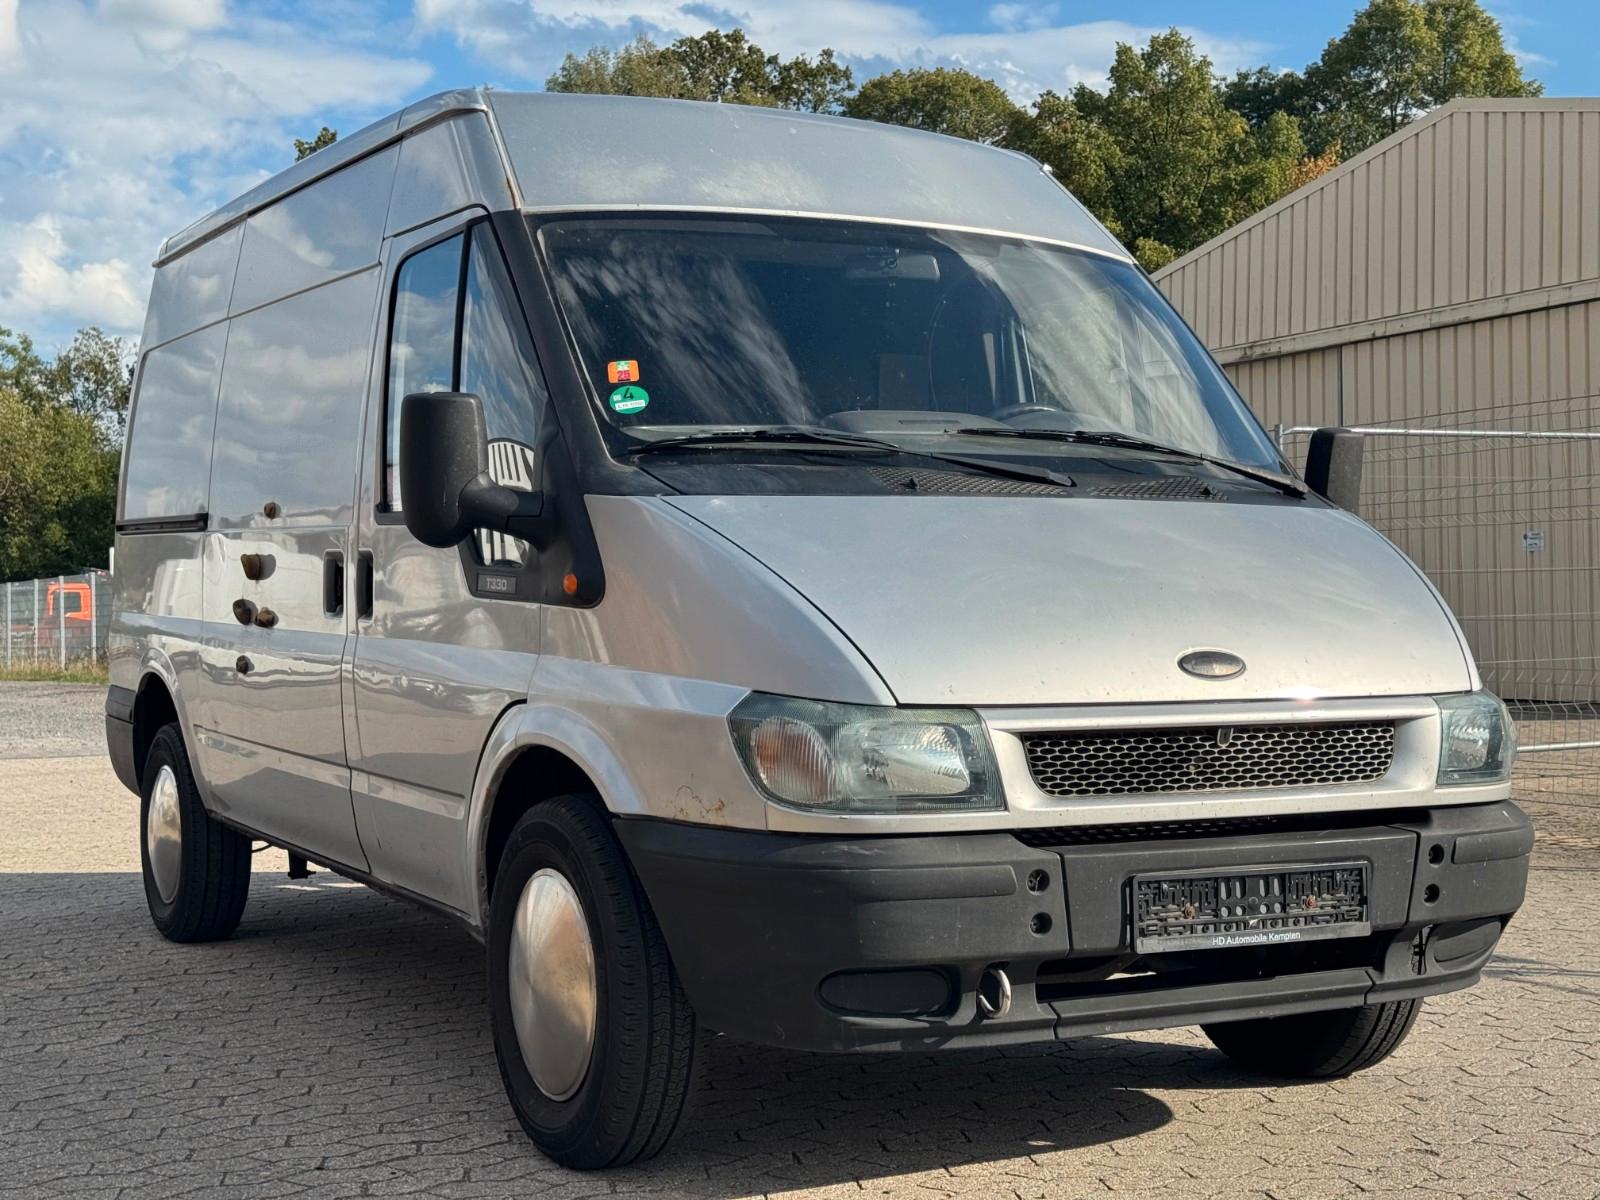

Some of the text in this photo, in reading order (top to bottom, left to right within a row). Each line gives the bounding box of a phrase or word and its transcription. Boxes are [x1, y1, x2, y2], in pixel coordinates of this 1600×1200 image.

[623, 387, 634, 399] 4
[486, 577, 508, 591] T330
[1212, 931, 1301, 946] HD Automobile Kempten
